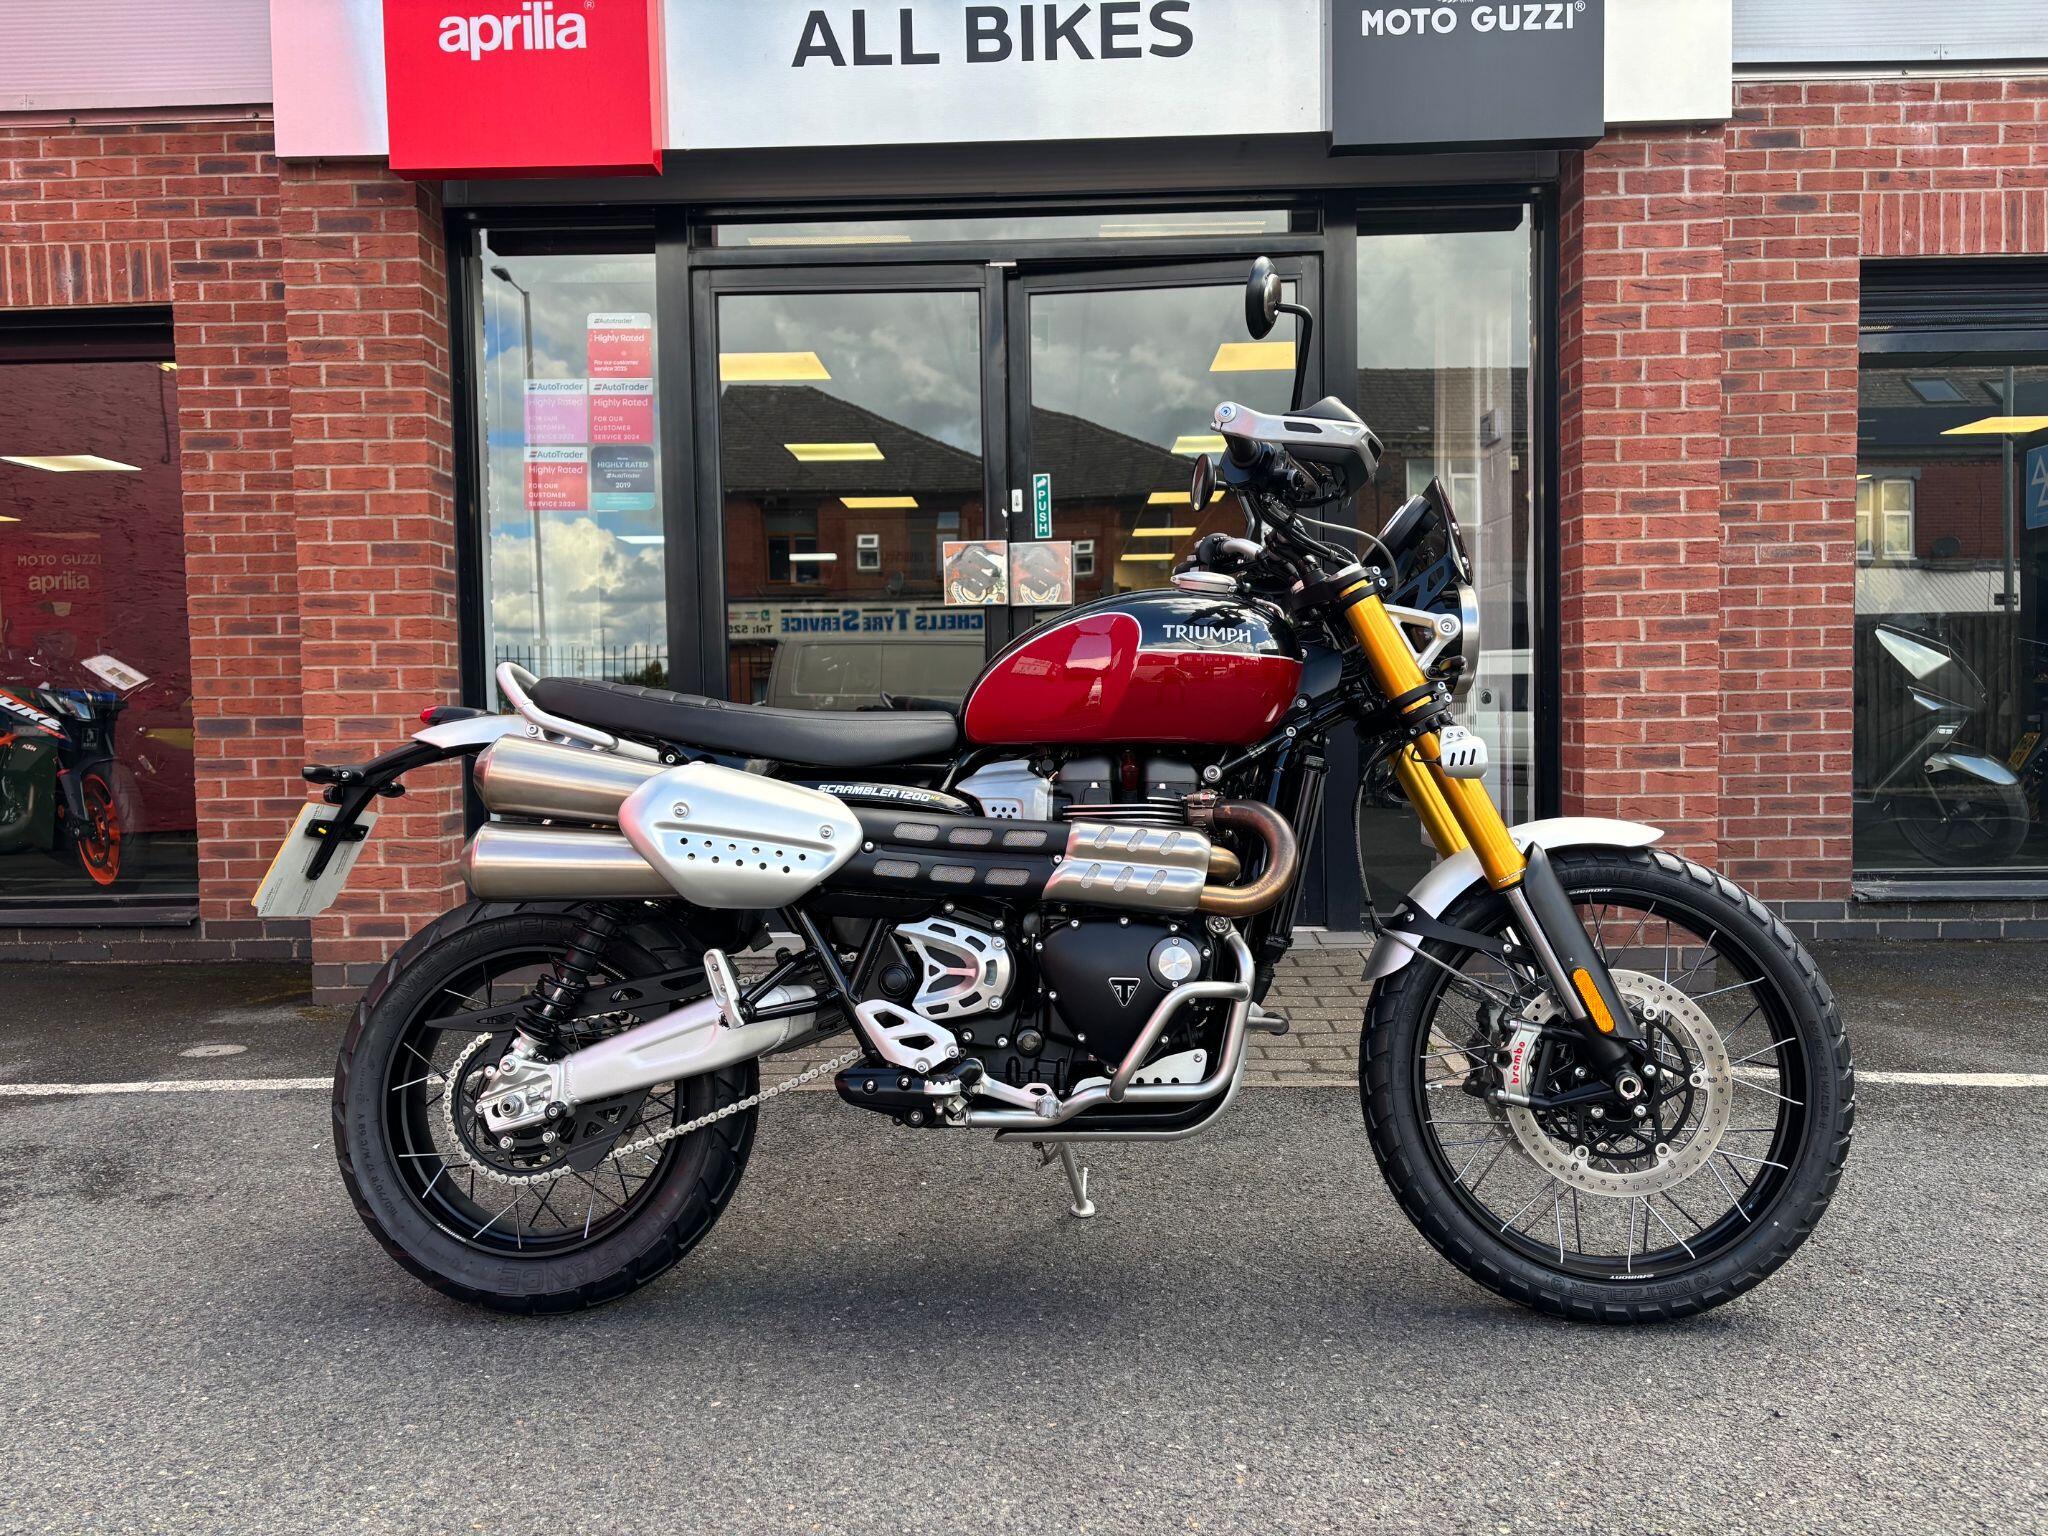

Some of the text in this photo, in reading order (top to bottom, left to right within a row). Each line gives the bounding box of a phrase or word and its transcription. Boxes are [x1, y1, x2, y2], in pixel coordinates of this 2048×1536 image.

[1361, 2, 1575, 36] MOTO GUZZI
[438, 1, 588, 60] aprilia
[792, 1, 1194, 68] ALL BIKES
[594, 334, 645, 343] Highly Rated
[537, 383, 584, 391] AutoTrader
[602, 383, 649, 391] AutoTrader
[594, 399, 648, 408] Highly Rated
[537, 451, 584, 459] AutoTrader
[529, 465, 583, 474] Highly Rated
[1037, 490, 1048, 533] PUSH
[18, 555, 57, 566] MOTO
[28, 570, 90, 594] aprilia
[1162, 624, 1251, 645] TRIUMPH
[0, 694, 62, 731] UKE
[817, 784, 898, 798] SCRAMBLER
[899, 790, 931, 802] 1200
[1511, 1041, 1526, 1084] brembo
